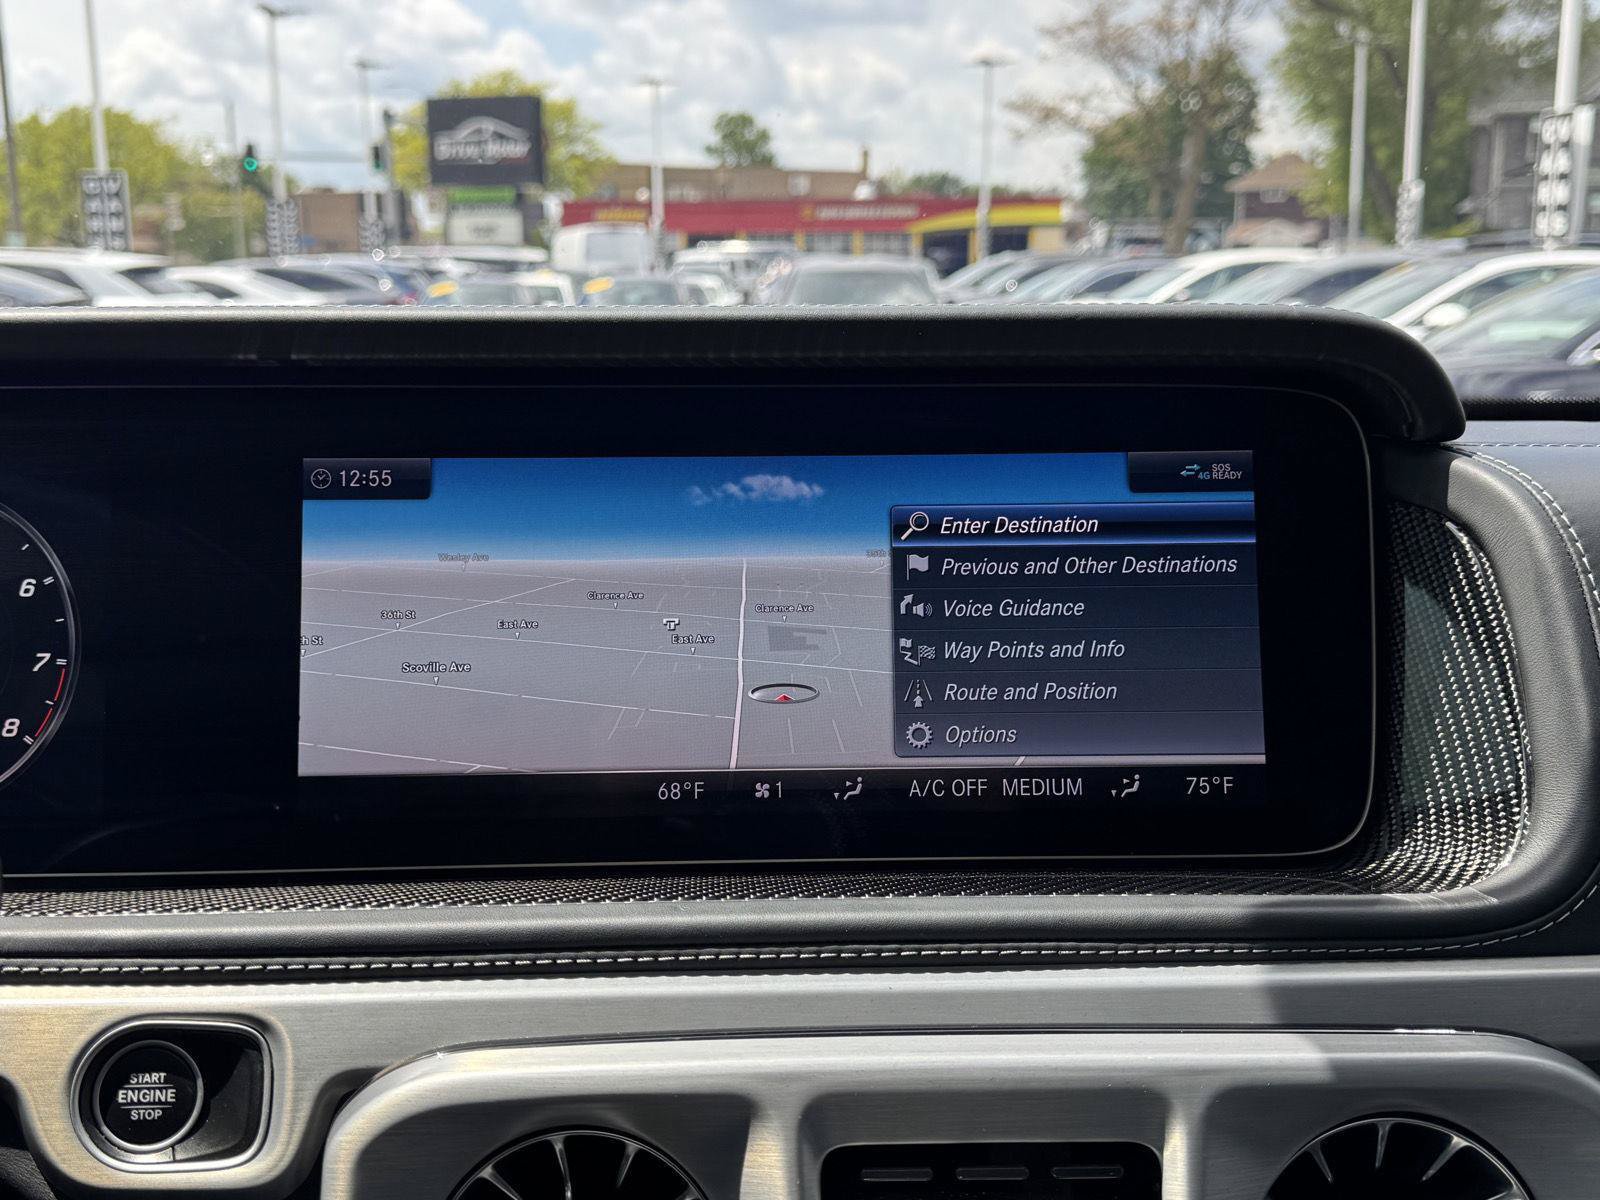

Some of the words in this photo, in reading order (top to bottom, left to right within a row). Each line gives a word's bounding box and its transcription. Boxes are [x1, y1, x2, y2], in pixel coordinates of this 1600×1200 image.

[1197, 471, 1211, 480] 4G
[1211, 463, 1231, 472] SOS
[1212, 471, 1242, 480] READY
[339, 469, 393, 487] 12:55
[940, 517, 990, 534] Enter
[994, 516, 1099, 534] Destination
[941, 557, 1018, 576] Previous
[1025, 557, 1060, 574] and
[1064, 557, 1116, 574] Other
[1121, 556, 1238, 574] Destinations
[18, 578, 37, 598] 6
[586, 590, 625, 600] Clarence
[626, 590, 645, 600] Ave
[380, 609, 403, 620] 36th
[404, 609, 416, 620] St
[754, 603, 795, 613] Clarence
[796, 603, 815, 613] Ave
[943, 599, 993, 617] Voice
[999, 599, 1085, 617] Guidance
[497, 619, 518, 630] East
[519, 619, 539, 630] Ave
[311, 635, 323, 646] St
[671, 634, 694, 645] East
[695, 634, 715, 645] Ave
[943, 641, 983, 663] Way
[987, 641, 1044, 659] Points
[1049, 640, 1083, 658] and
[1090, 640, 1125, 658] Info
[32, 652, 51, 672] 7
[402, 660, 447, 673] Scoville
[449, 660, 472, 673] Ave
[944, 683, 998, 701] Route
[1004, 682, 1039, 700] and
[1043, 682, 1118, 700] Position
[1, 718, 20, 738] 8
[945, 725, 1017, 748] Options
[658, 782, 705, 799] 68°F
[909, 779, 945, 797] A/C
[952, 779, 988, 797] OFF
[1002, 778, 1083, 797] MEDIUM
[1185, 776, 1234, 795] 75°F
[129, 1072, 166, 1085] START
[117, 1089, 176, 1103] ENGINE
[130, 1108, 163, 1121] STOP
